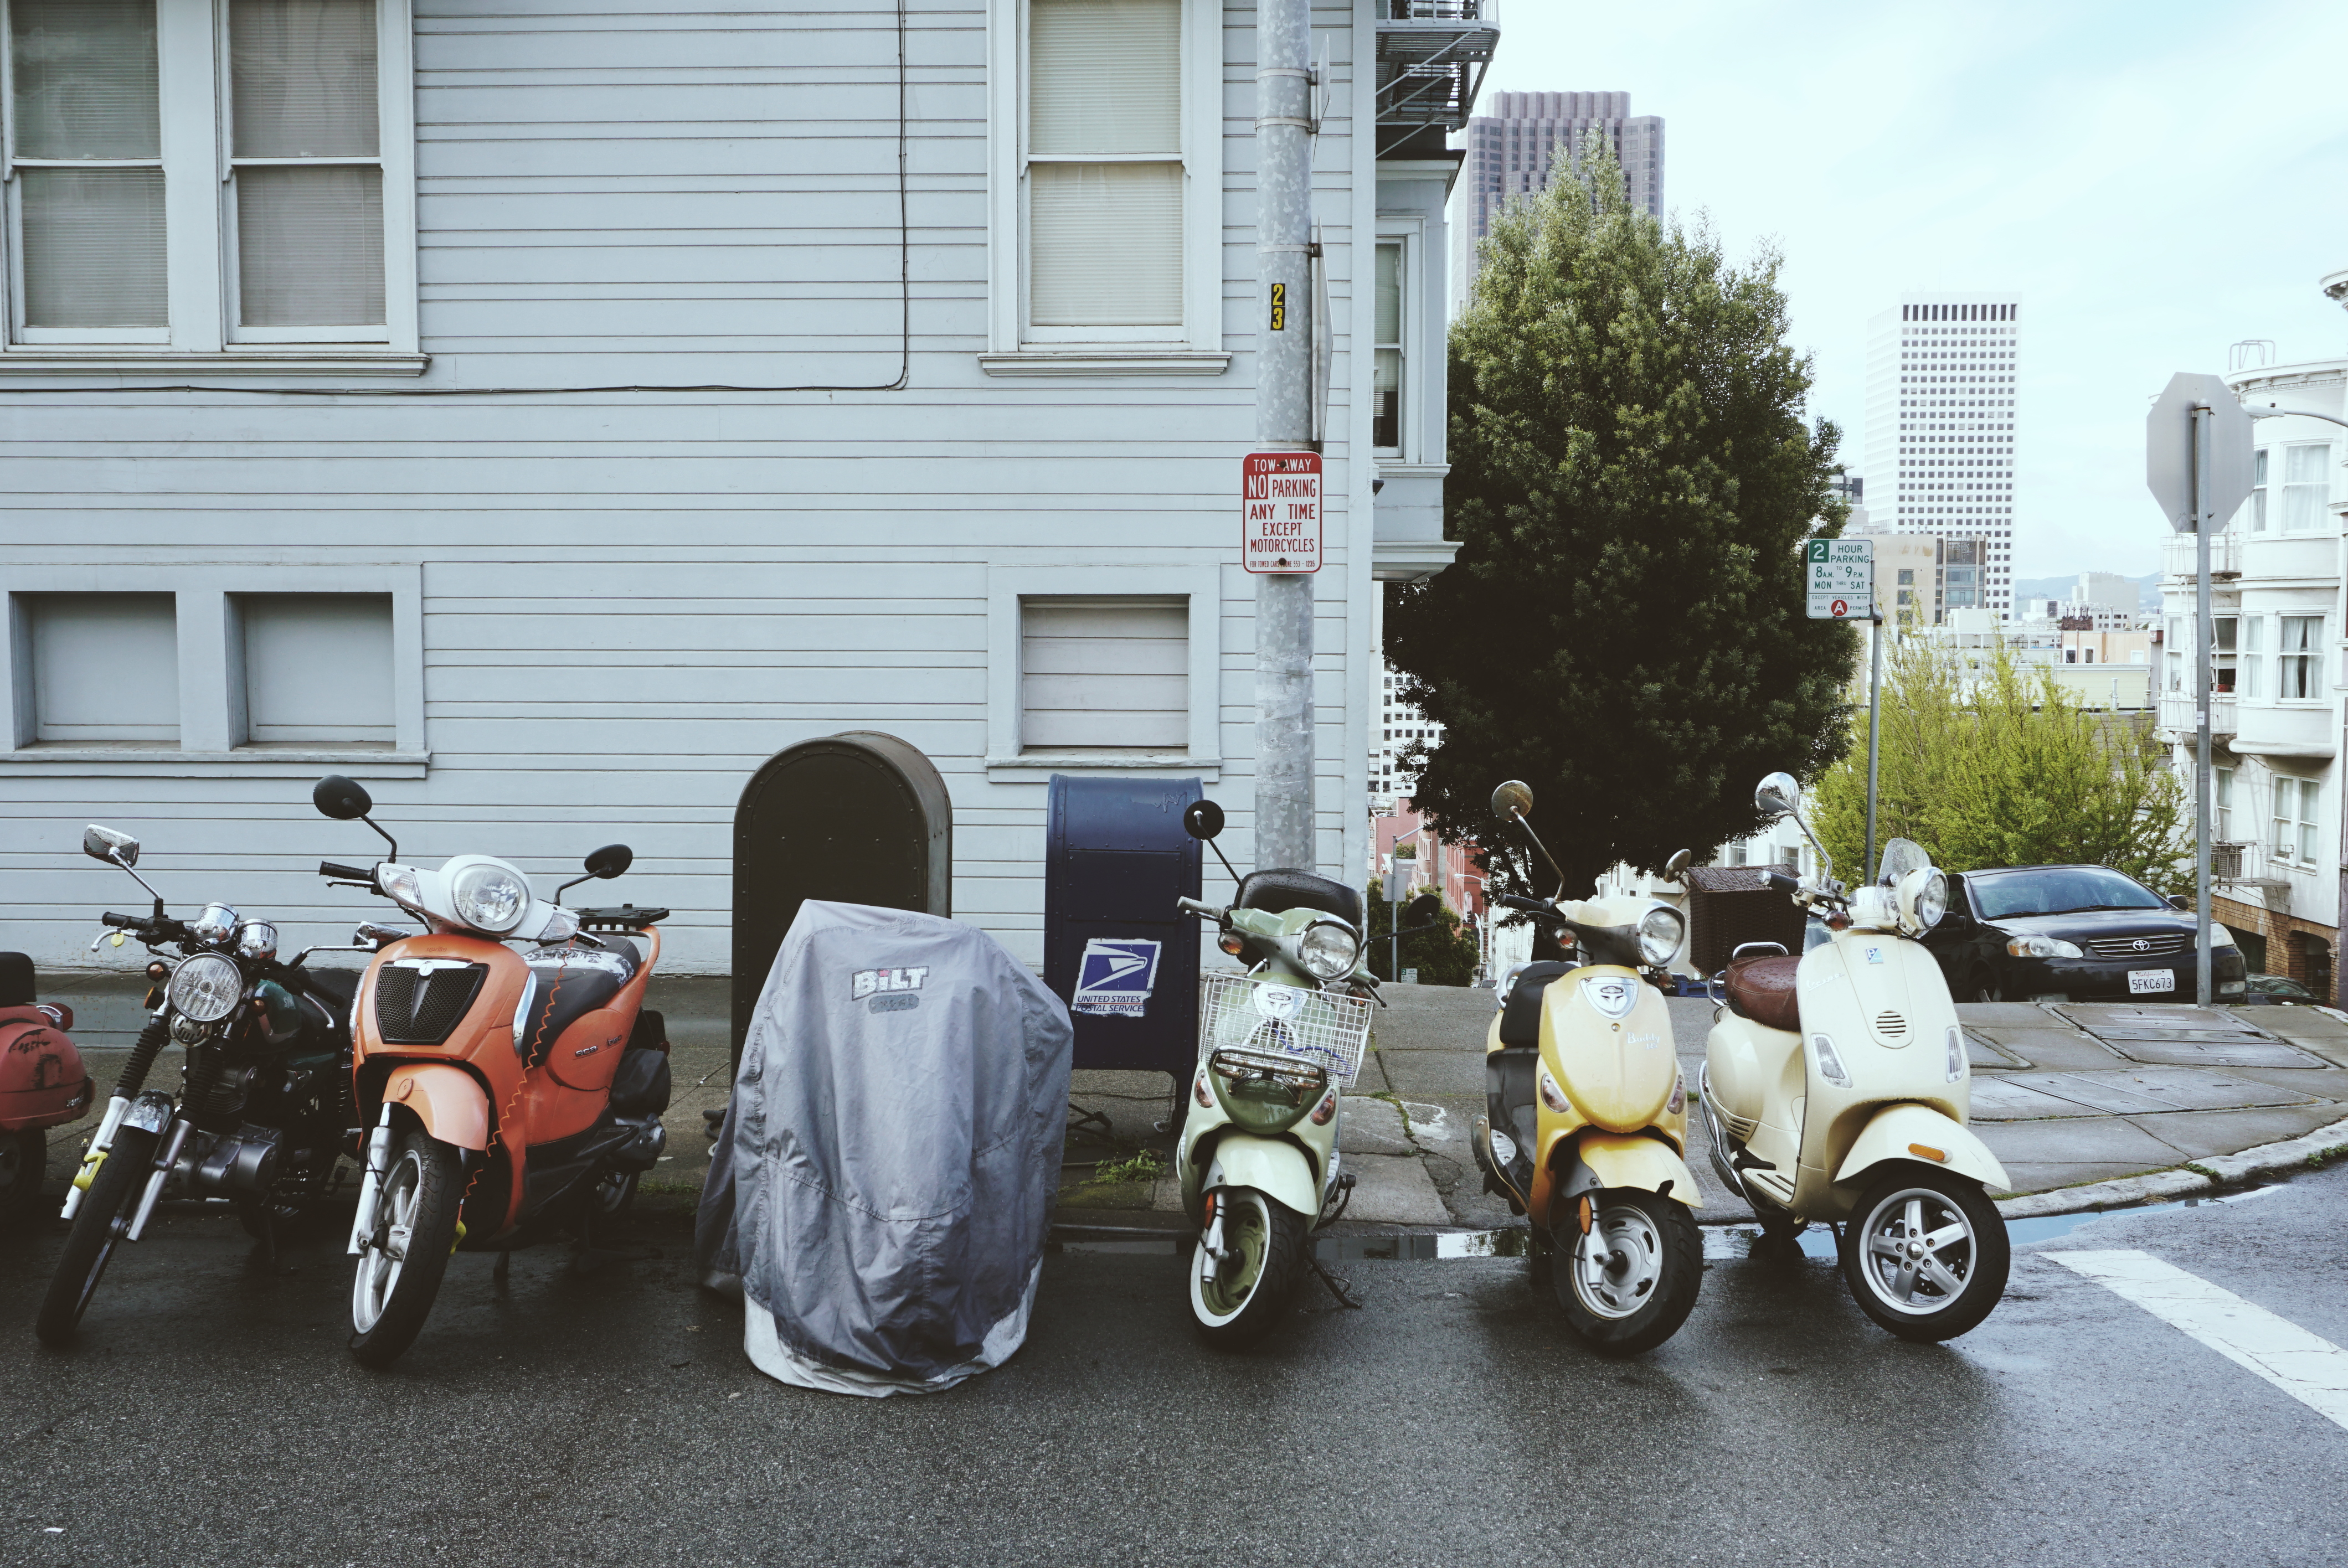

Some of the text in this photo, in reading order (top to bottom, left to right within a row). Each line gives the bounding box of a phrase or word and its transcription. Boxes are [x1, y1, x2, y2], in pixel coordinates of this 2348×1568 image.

[1273, 283, 1284, 329] 23
[1248, 474, 1316, 498] NO PARKING
[1250, 503, 1315, 519] ANY TIME
[1263, 522, 1302, 536] EXCEPT
[1250, 538, 1315, 553] MOTORCYCLES
[1813, 543, 1825, 559] 2
[1838, 545, 1863, 553] HOUR
[1830, 555, 1870, 563] PARKING
[1815, 581, 1831, 589] MON
[1850, 581, 1865, 589] SAT
[1834, 601, 1845, 613] A
[2132, 977, 2172, 990] 5FKC673
[1626, 1032, 1660, 1044] Buddy
